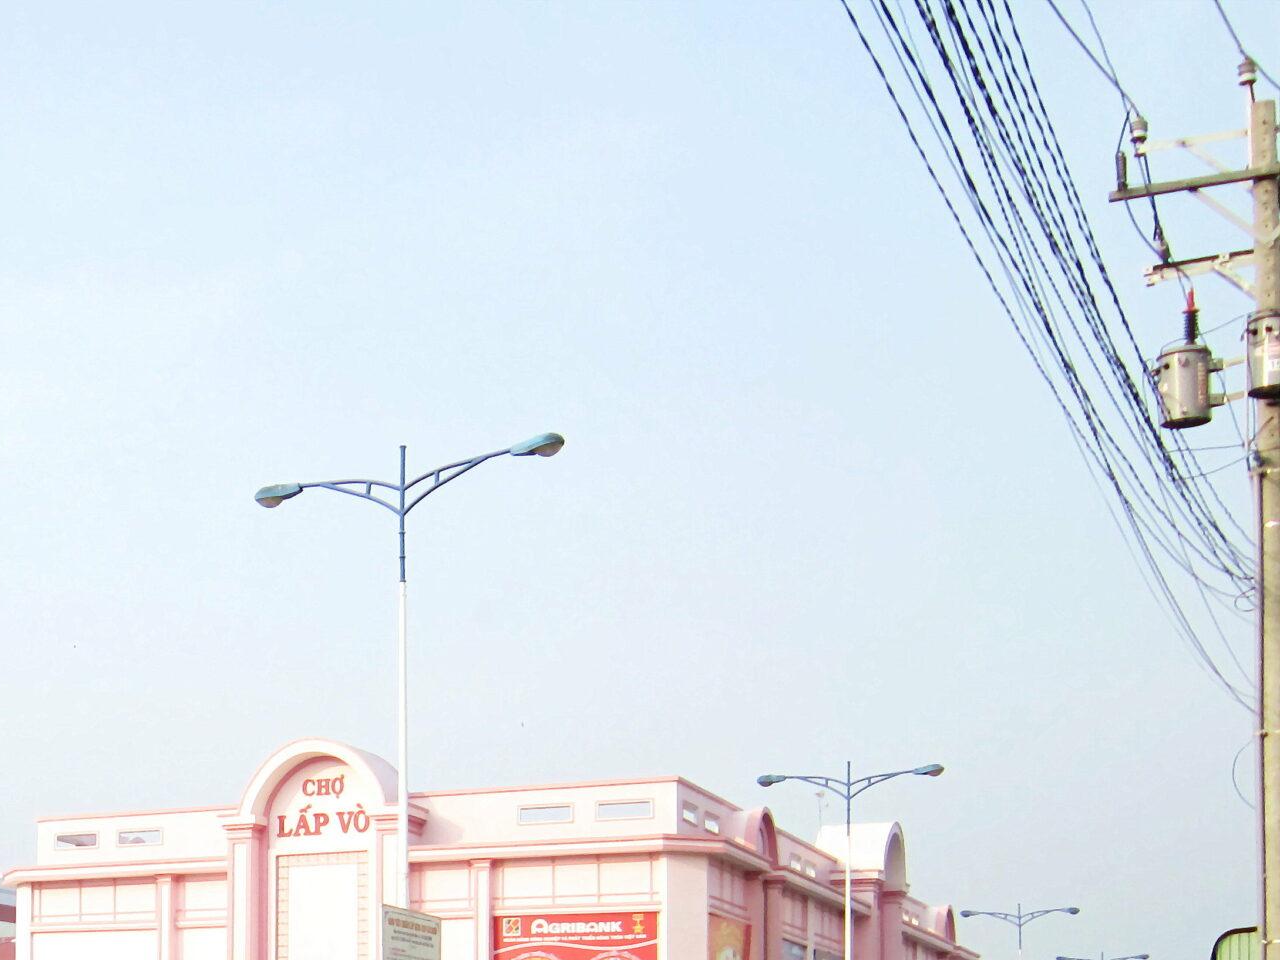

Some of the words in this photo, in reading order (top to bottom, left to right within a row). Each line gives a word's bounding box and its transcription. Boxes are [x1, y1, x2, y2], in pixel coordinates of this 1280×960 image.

[302, 774, 344, 799] CHỢ
[277, 804, 330, 838] LẤP
[336, 803, 370, 833] VÒ
